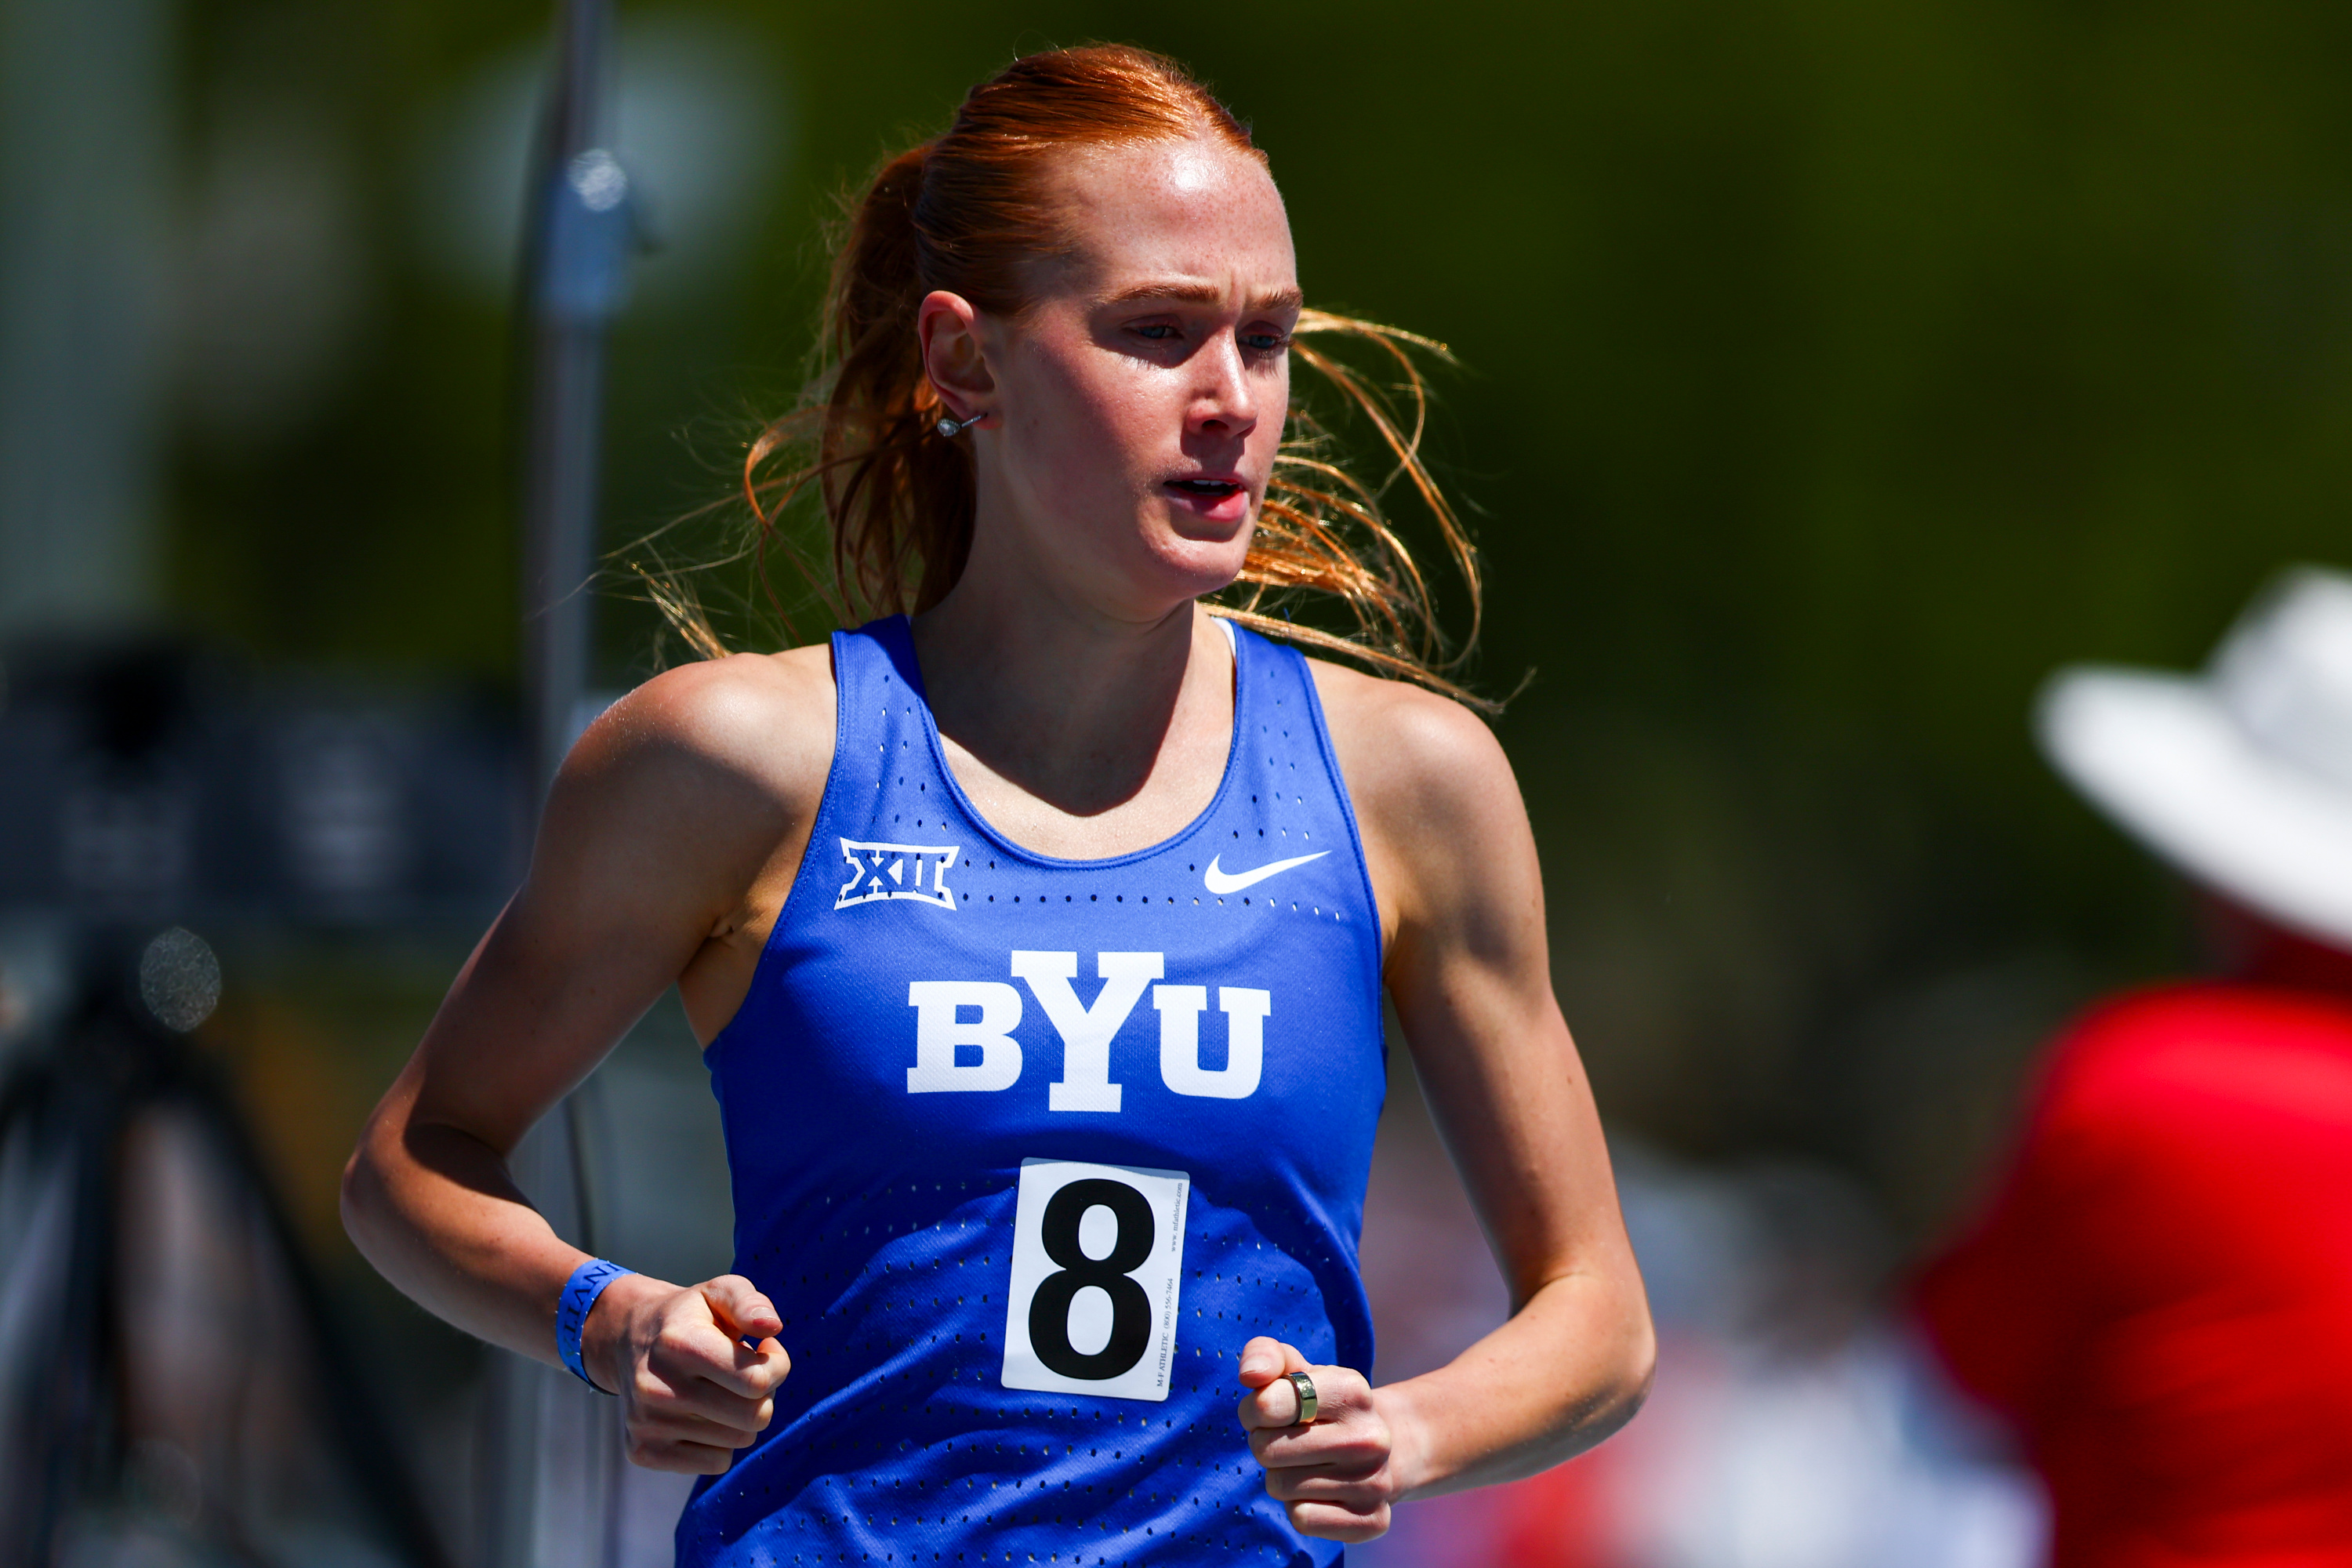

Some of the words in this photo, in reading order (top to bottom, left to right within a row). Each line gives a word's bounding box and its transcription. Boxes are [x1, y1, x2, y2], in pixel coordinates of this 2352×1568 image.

[835, 838, 959, 910] XII
[907, 950, 1271, 1112] BYU
[564, 1263, 622, 1374] INVITA
[1028, 1178, 1156, 1381] 8
[1163, 1311, 1172, 1330] (800)
[1159, 1332, 1169, 1371] ATHLETIC
